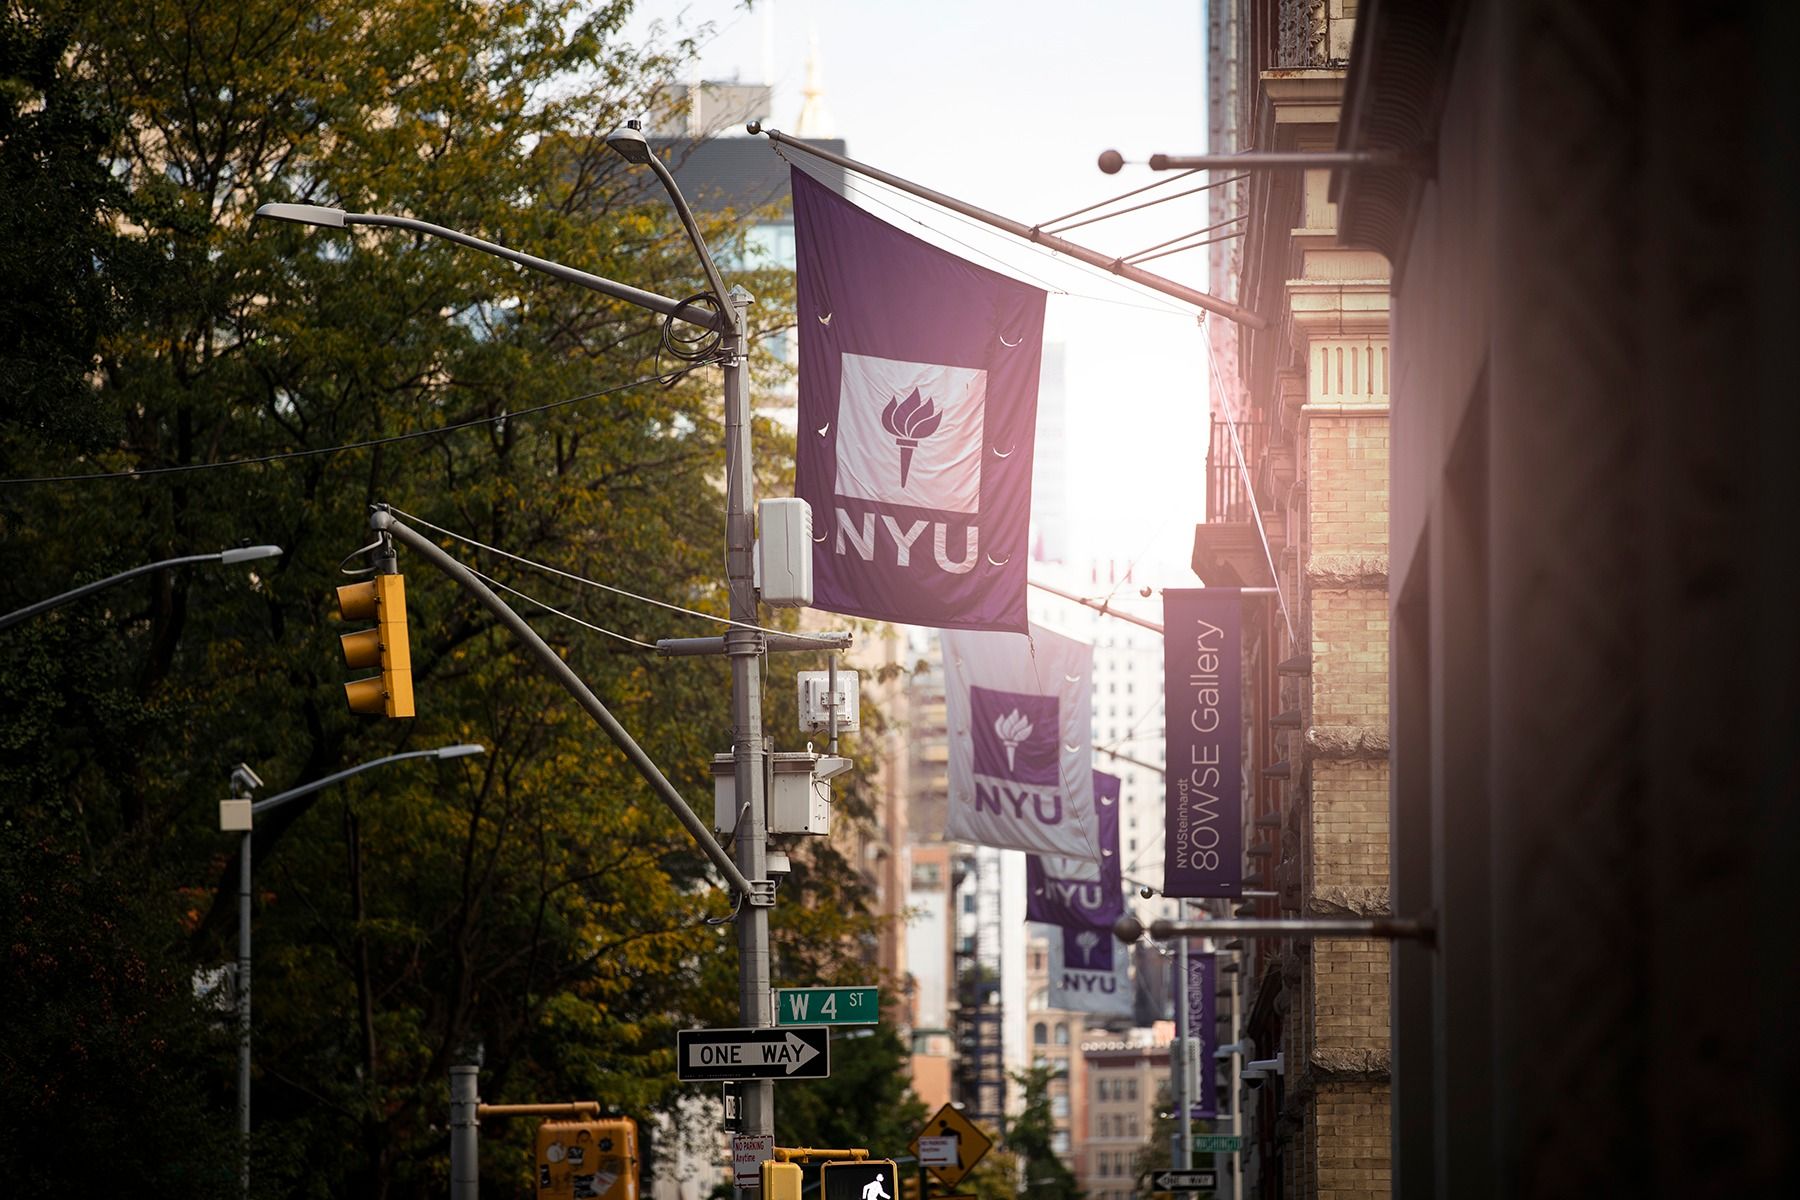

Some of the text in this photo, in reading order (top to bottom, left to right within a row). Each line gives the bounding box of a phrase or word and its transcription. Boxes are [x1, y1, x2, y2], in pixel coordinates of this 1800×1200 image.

[835, 507, 980, 575] NYU
[1190, 619, 1224, 732] Gallery
[975, 781, 1062, 826] NYU
[1044, 879, 1103, 910] NYU
[1062, 973, 1117, 994] NYU
[790, 992, 864, 1021] W 4 ST
[700, 1044, 805, 1064] ONE WAY
[735, 1141, 764, 1151] NO PARKING
[736, 1154, 756, 1164] Anytime
[1163, 1175, 1209, 1185] ONE WAY
